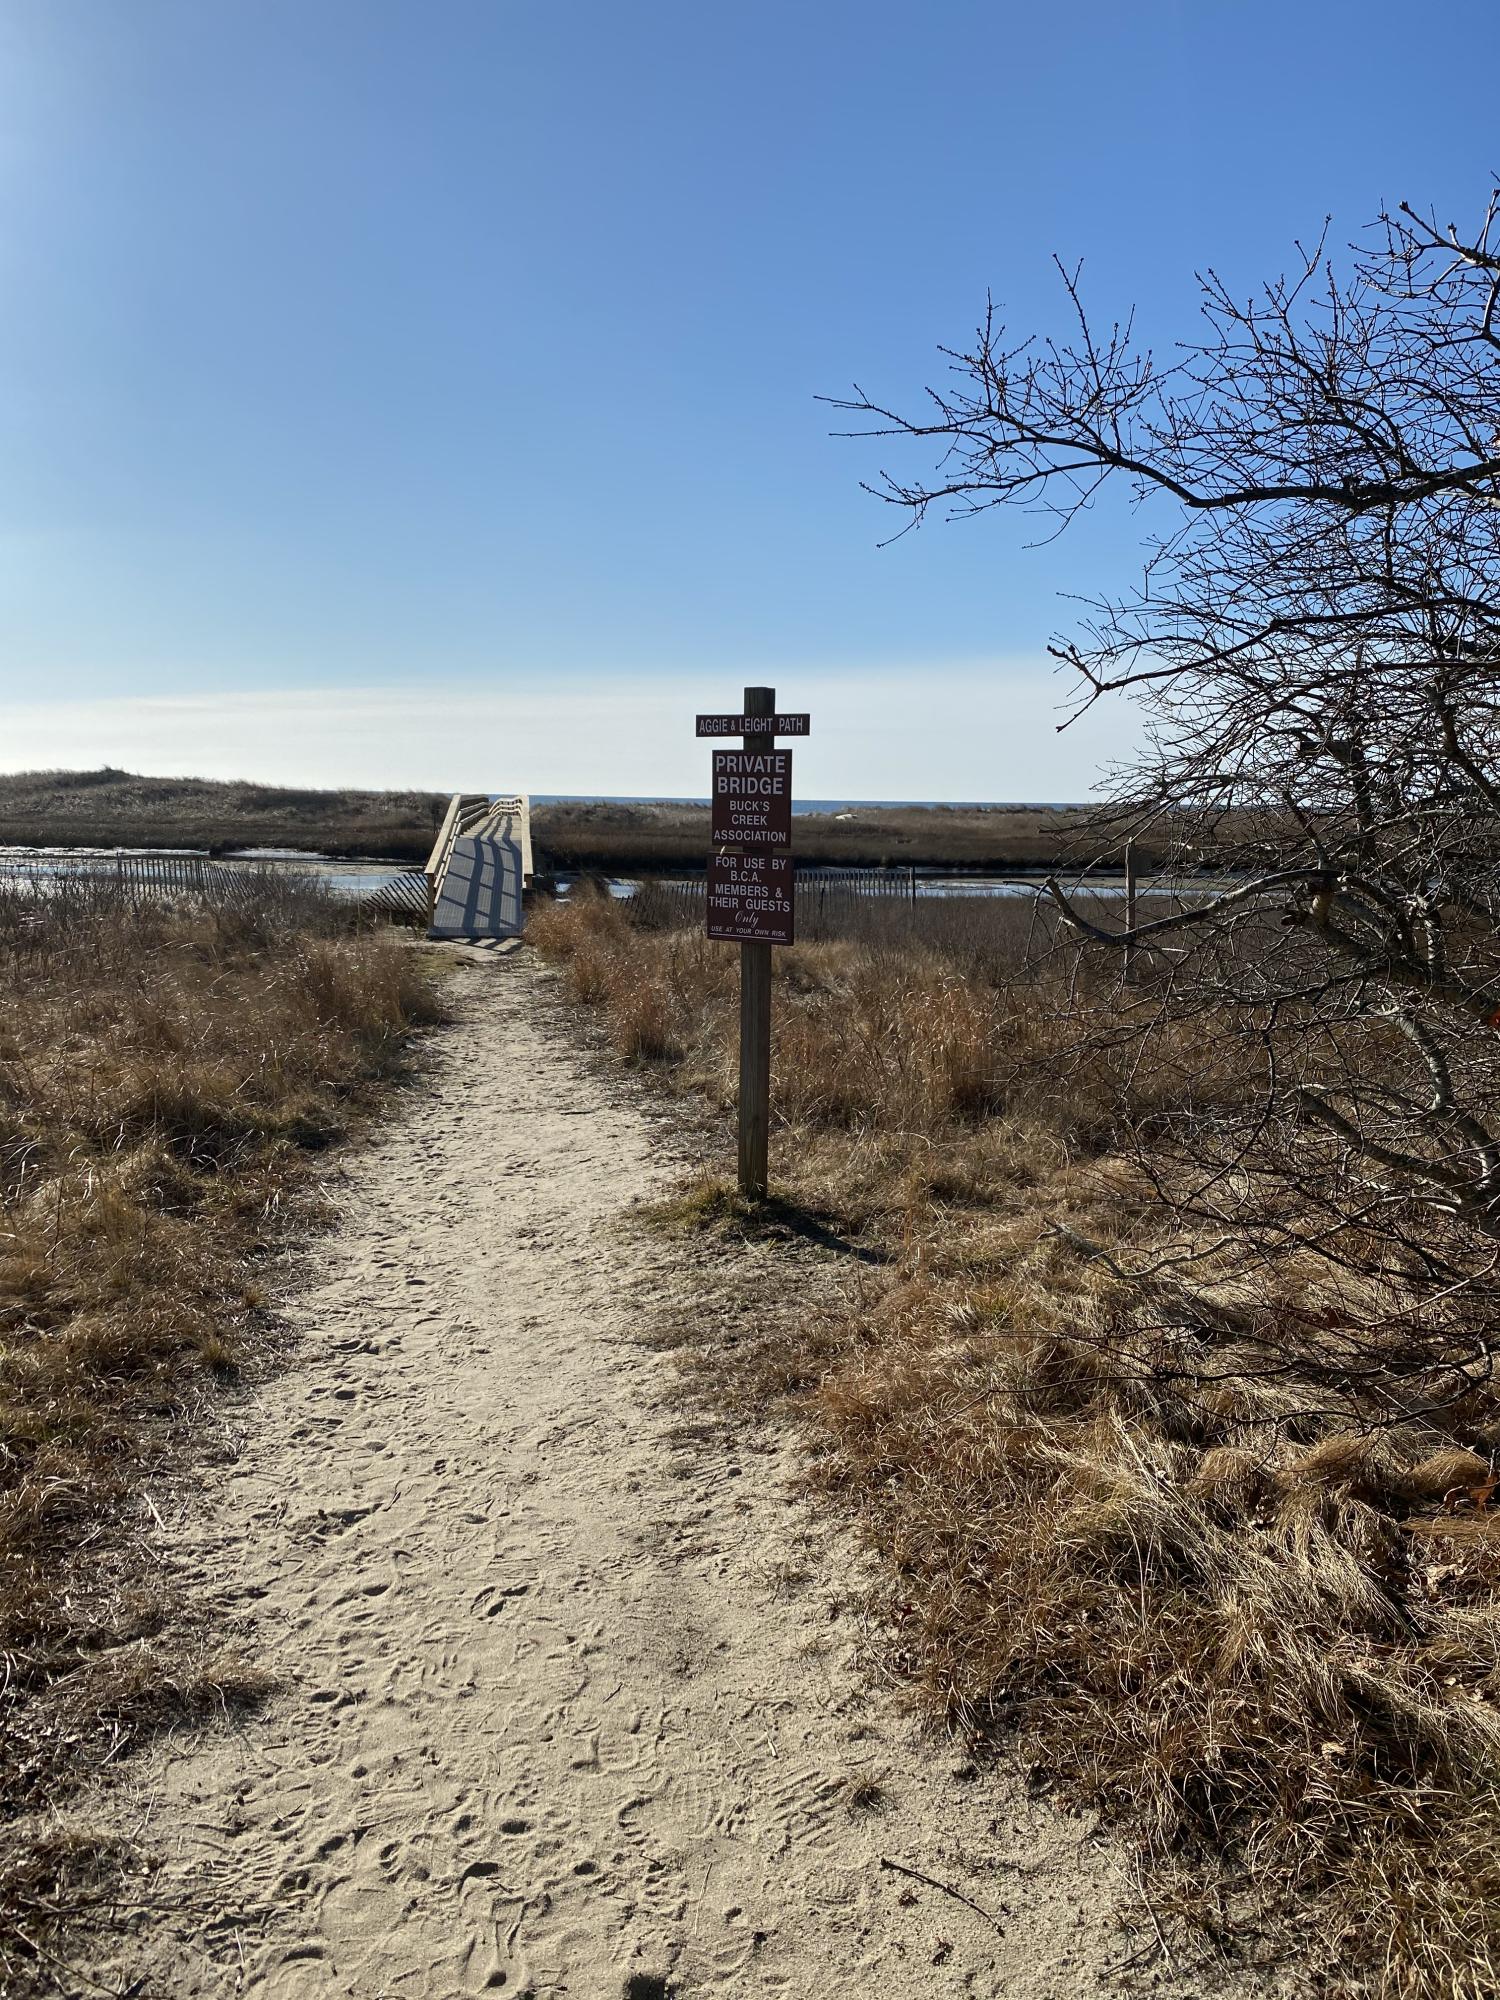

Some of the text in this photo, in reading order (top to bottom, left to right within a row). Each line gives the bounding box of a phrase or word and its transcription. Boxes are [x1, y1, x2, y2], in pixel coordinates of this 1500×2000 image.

[699, 717, 803, 733] AGGIE & LEIGHT PATH
[715, 755, 786, 773] PRIVATE
[717, 776, 783, 795] BRIDGE
[729, 800, 770, 812] BUCK'S
[731, 814, 767, 826] CREEK
[713, 829, 786, 842] ASSOCIATION
[715, 856, 787, 870] FOR USE BY
[730, 870, 762, 883] B.C.A.
[715, 883, 783, 898] MEMBERS &
[708, 896, 790, 912] THEIR GUESTS
[735, 910, 759, 928] Only
[754, 928, 769, 936] OWN
